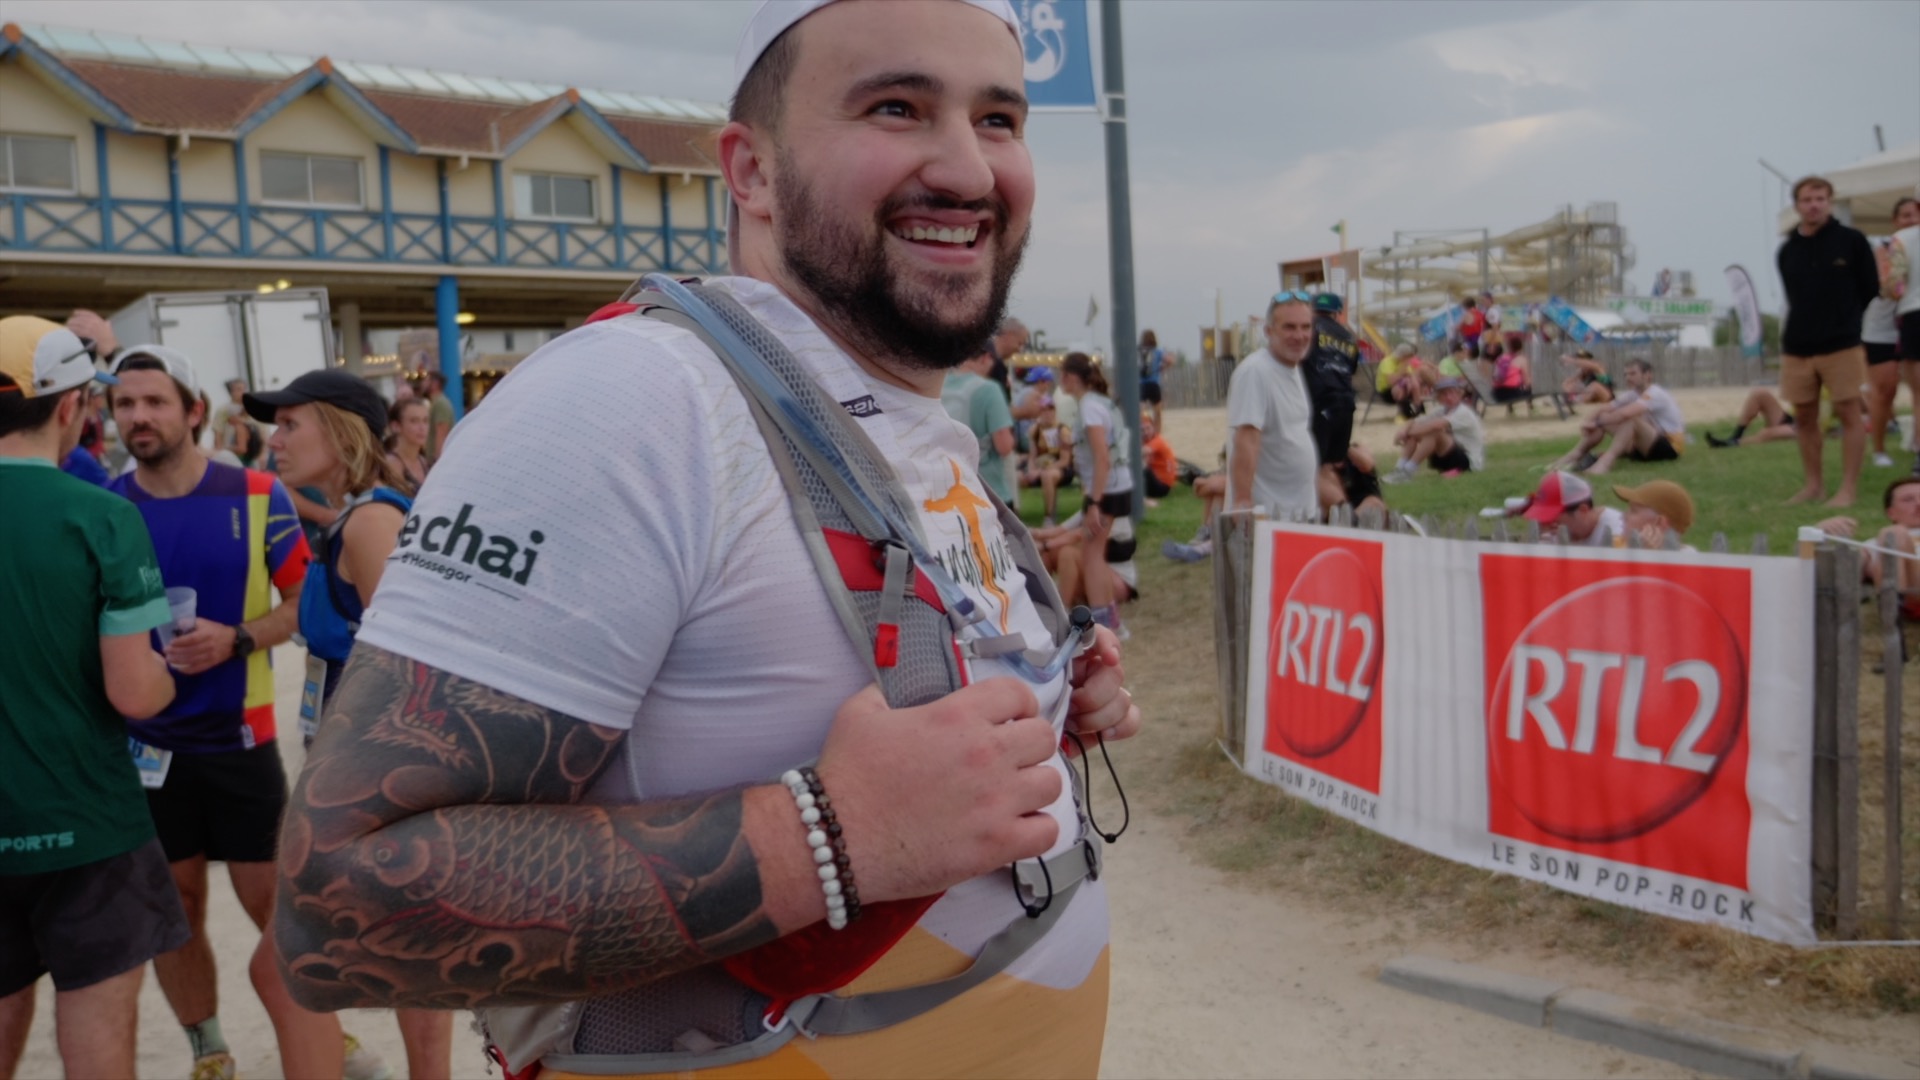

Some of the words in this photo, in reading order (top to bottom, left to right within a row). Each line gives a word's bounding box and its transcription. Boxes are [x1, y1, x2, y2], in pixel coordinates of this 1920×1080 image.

[1277, 599, 1375, 702] RTL2
[1505, 643, 1722, 775] RTL2
[1262, 758, 1274, 777] LE
[1279, 766, 1302, 789] SON
[1307, 777, 1378, 820] POP-ROCK
[0, 831, 75, 853] PORTS
[1491, 842, 1516, 865] LE
[1529, 852, 1579, 881] SON
[1595, 868, 1756, 922] POP-ROCK
